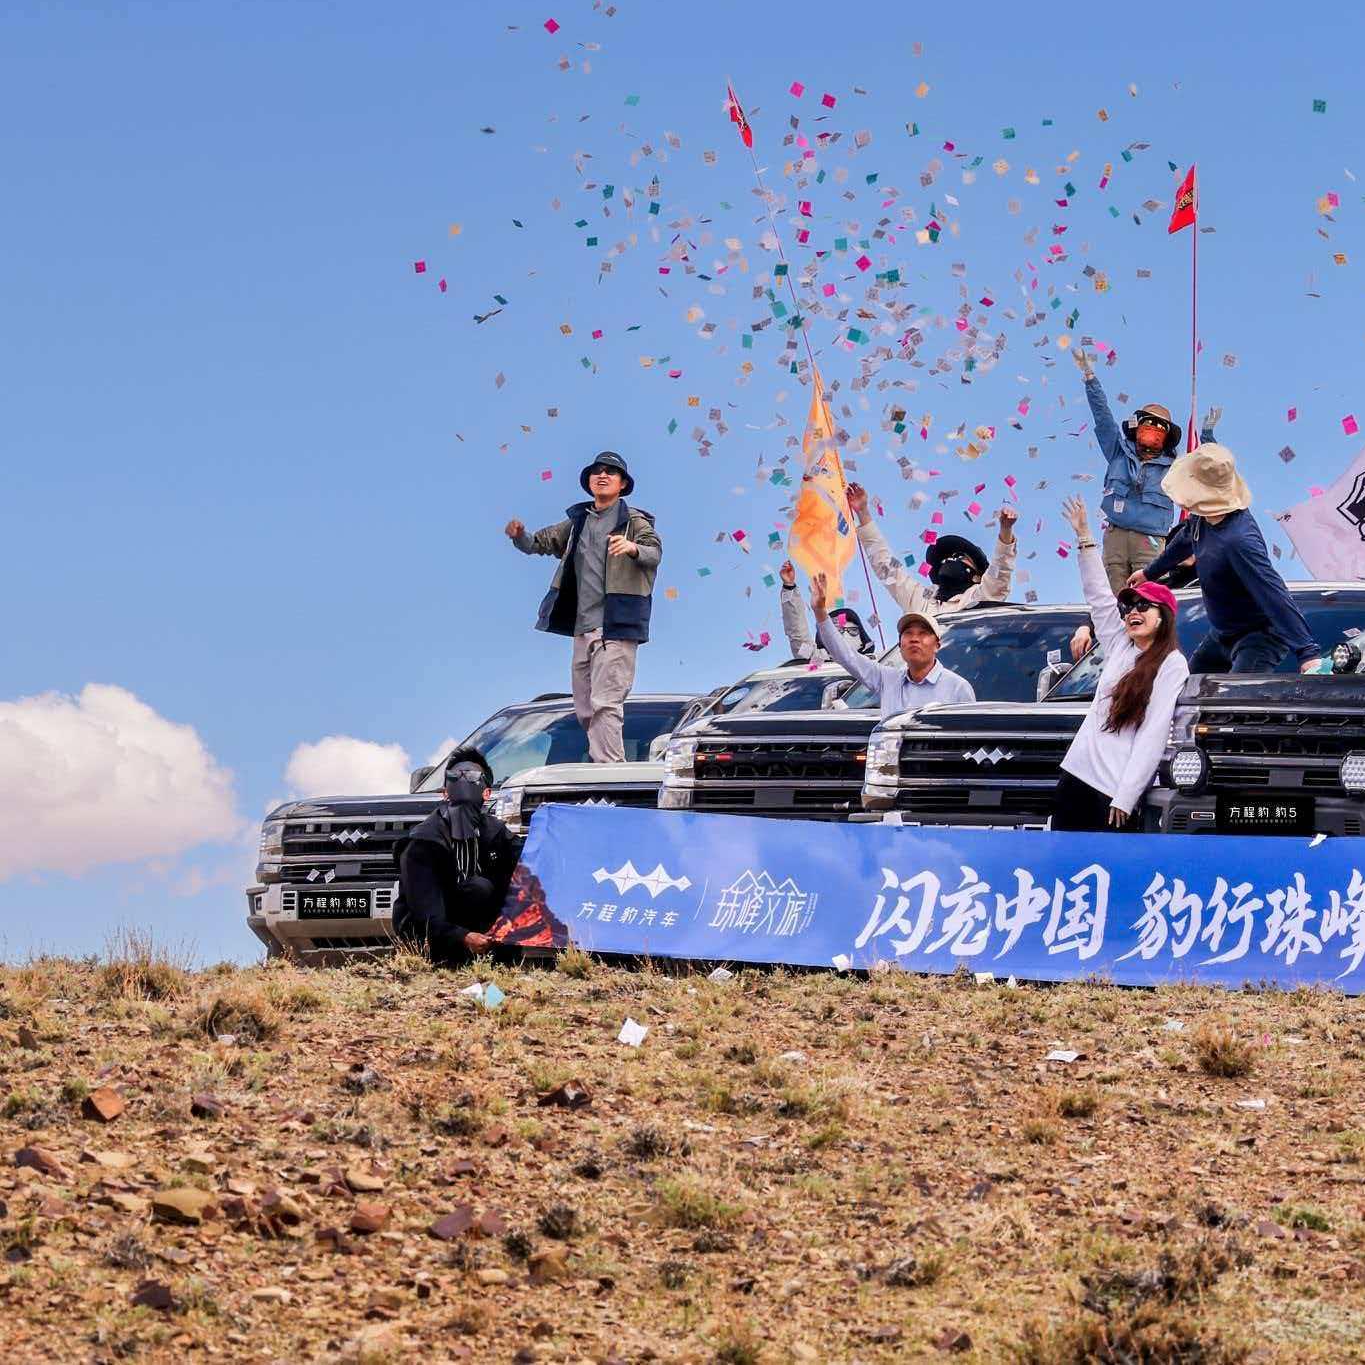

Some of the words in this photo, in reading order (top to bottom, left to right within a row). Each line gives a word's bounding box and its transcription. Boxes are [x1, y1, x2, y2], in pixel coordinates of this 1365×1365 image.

[1229, 806, 1270, 818] 方程豹
[1275, 806, 1298, 818] 豹5
[303, 897, 341, 909] 方程豹
[346, 897, 368, 909] 豹5
[854, 863, 1111, 962] 闪充中国
[576, 900, 680, 929] 方程豹汽车
